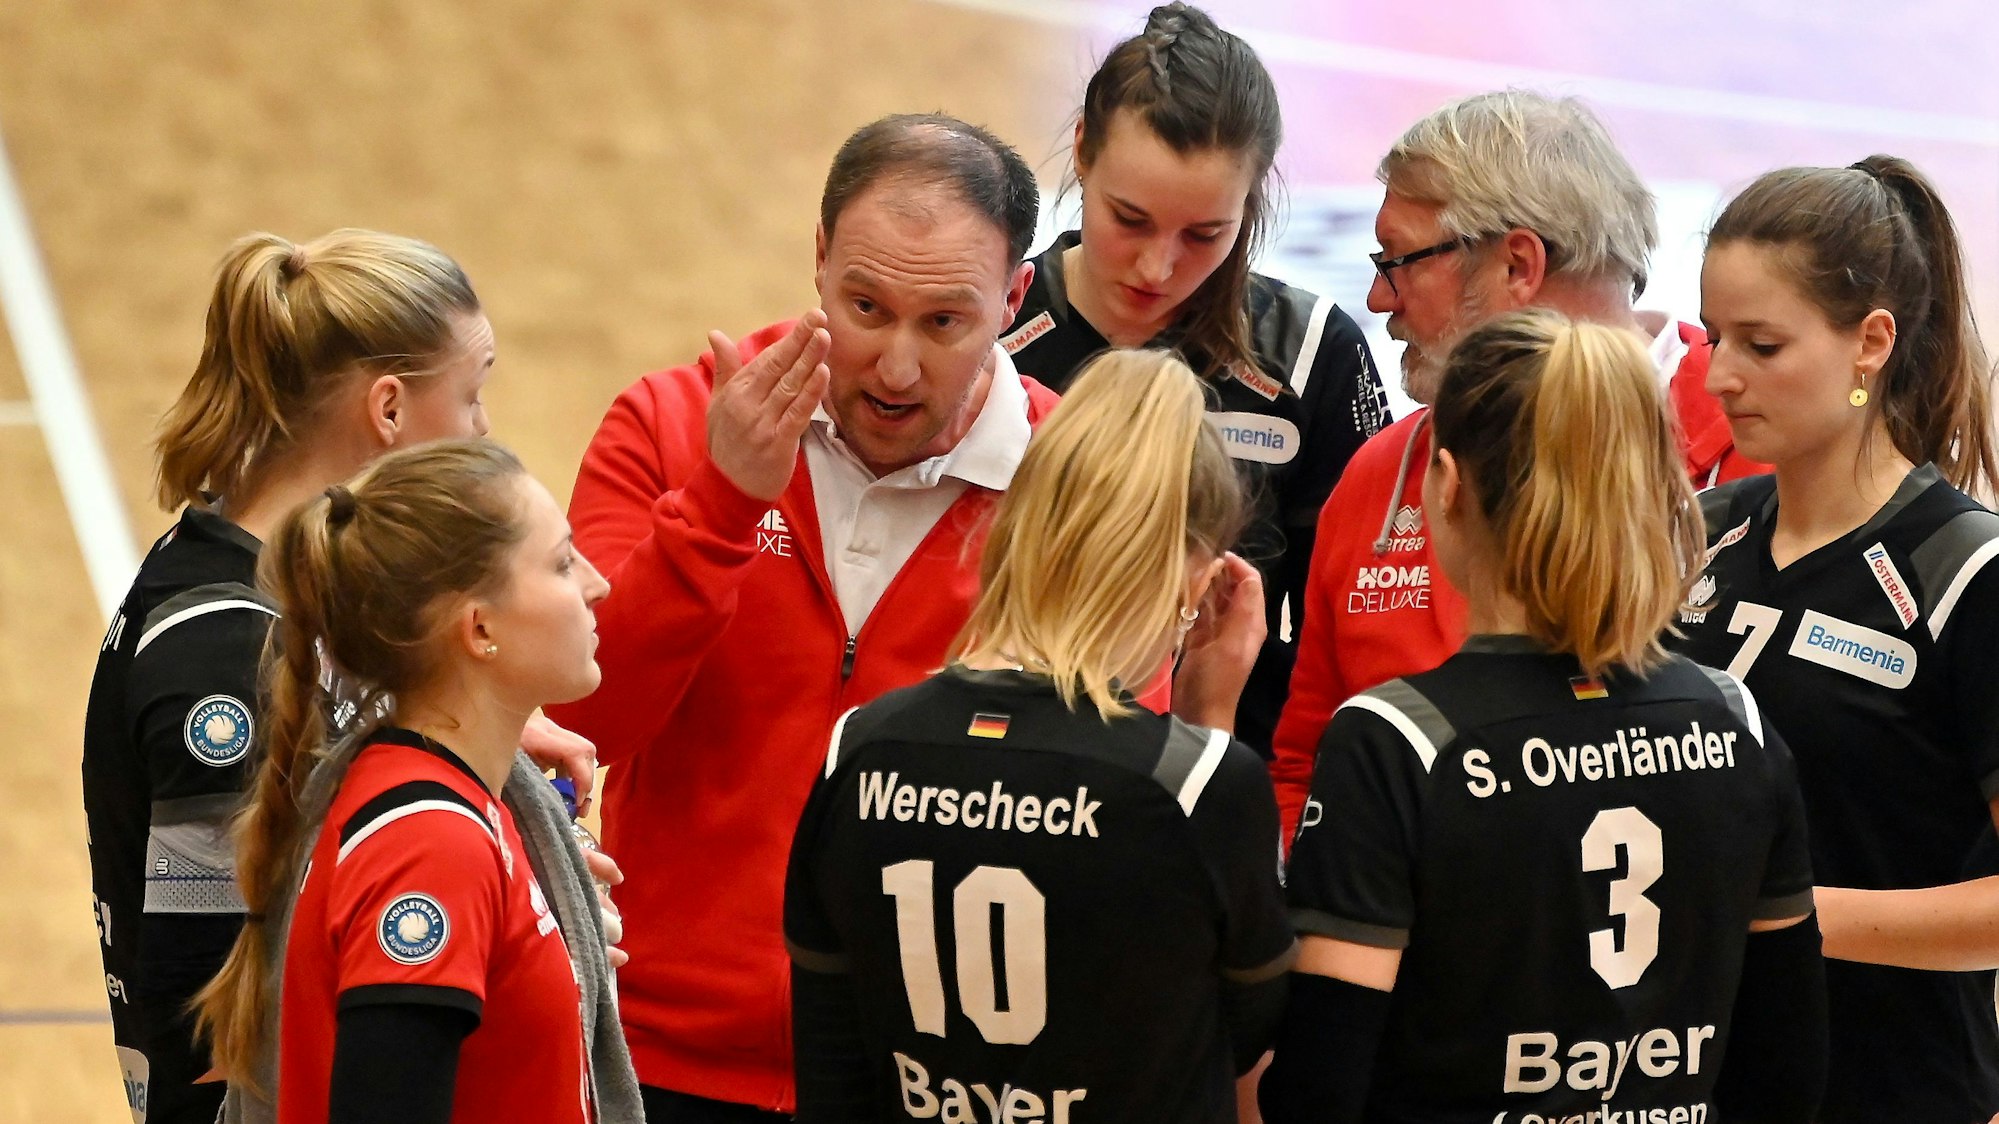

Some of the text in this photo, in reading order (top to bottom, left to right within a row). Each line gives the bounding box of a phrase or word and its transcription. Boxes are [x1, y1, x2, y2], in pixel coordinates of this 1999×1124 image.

[1348, 589, 1431, 613] DELUXE
[1357, 566, 1430, 589] HOME
[1874, 559, 1914, 625] OSTERMANN
[1727, 601, 1783, 683] 7
[1807, 625, 1905, 675] Barmenia
[194, 704, 244, 728] VOLLEYBALL
[196, 736, 245, 757] BUNDESLIGA
[1462, 721, 1737, 798] S. Overländer
[859, 771, 1102, 838] Werscheck
[388, 901, 440, 925] VOLLEYBALL
[1581, 806, 1663, 990] 3
[387, 934, 438, 955] BUNDESLIGA
[882, 859, 1046, 1046] 10
[893, 1052, 1087, 1124] Bayer
[1503, 1025, 1716, 1101] Bayer
